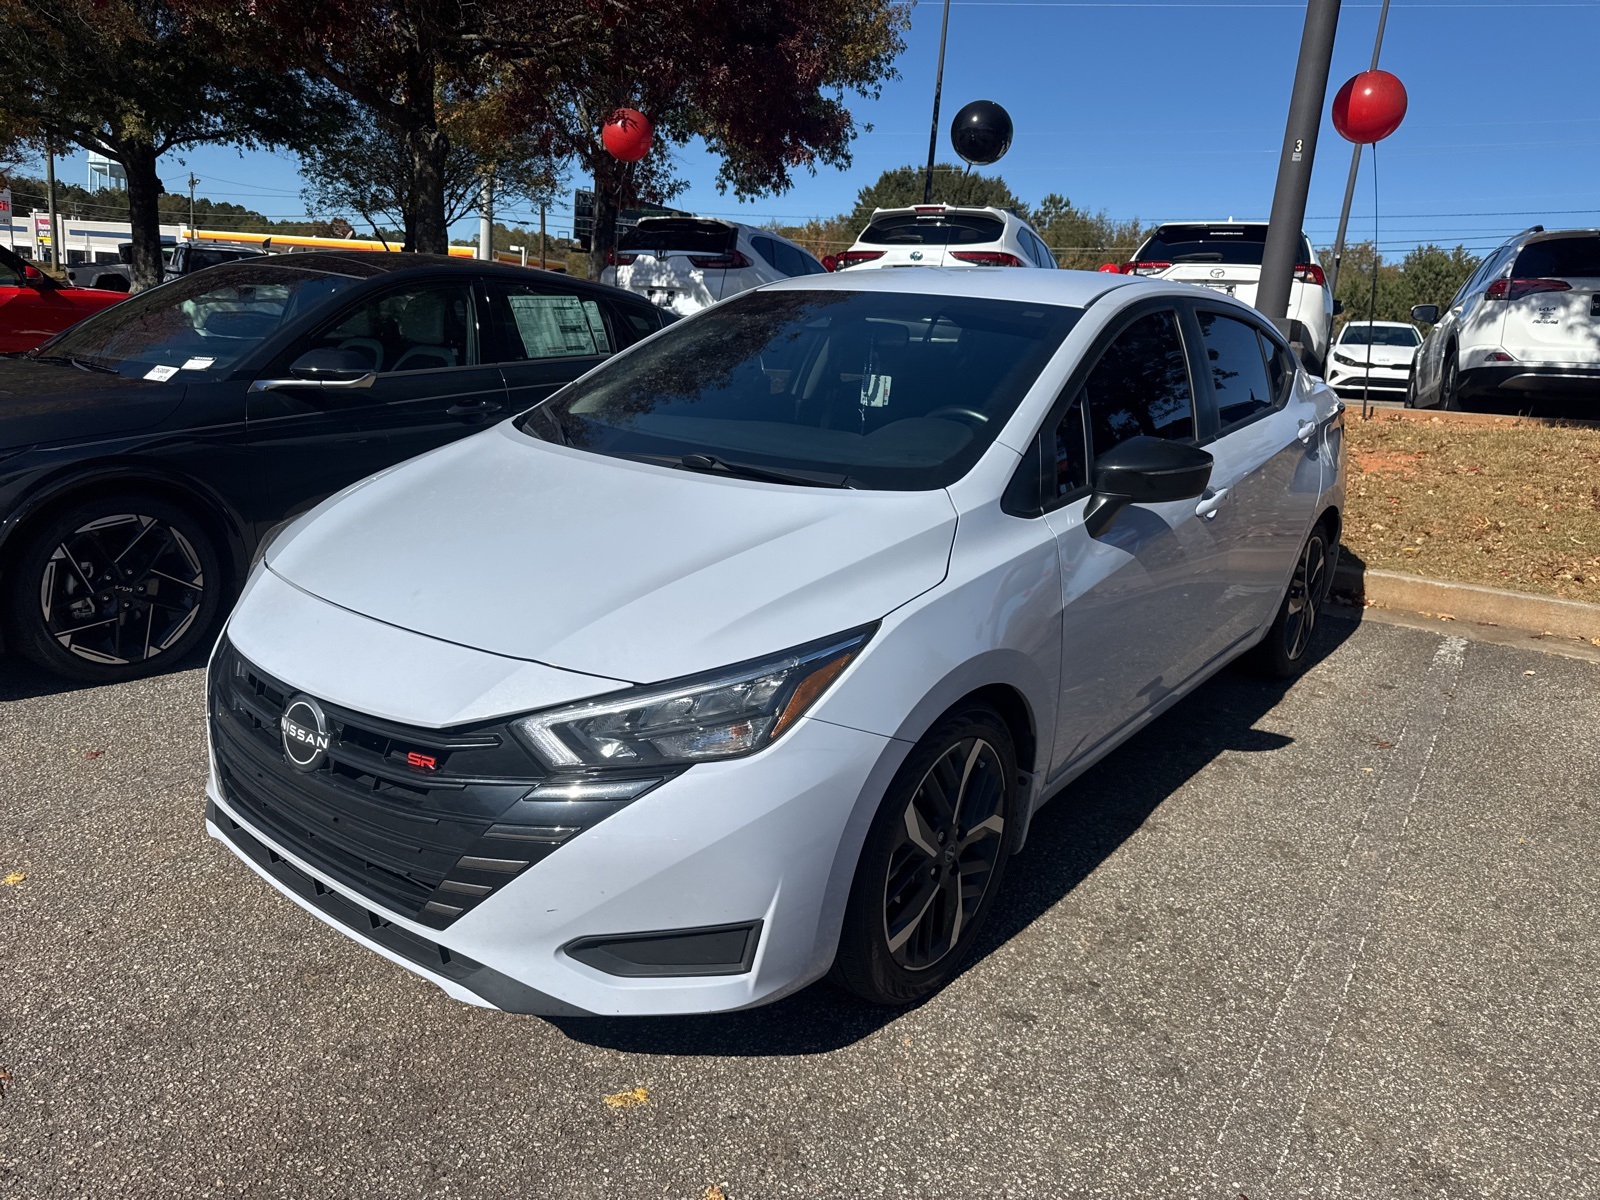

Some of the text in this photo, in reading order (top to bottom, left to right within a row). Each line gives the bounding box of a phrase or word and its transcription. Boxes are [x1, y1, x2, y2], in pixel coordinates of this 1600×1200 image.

[1295, 139, 1303, 152] 3
[280, 716, 329, 750] NISSAN
[407, 751, 437, 771] SR
